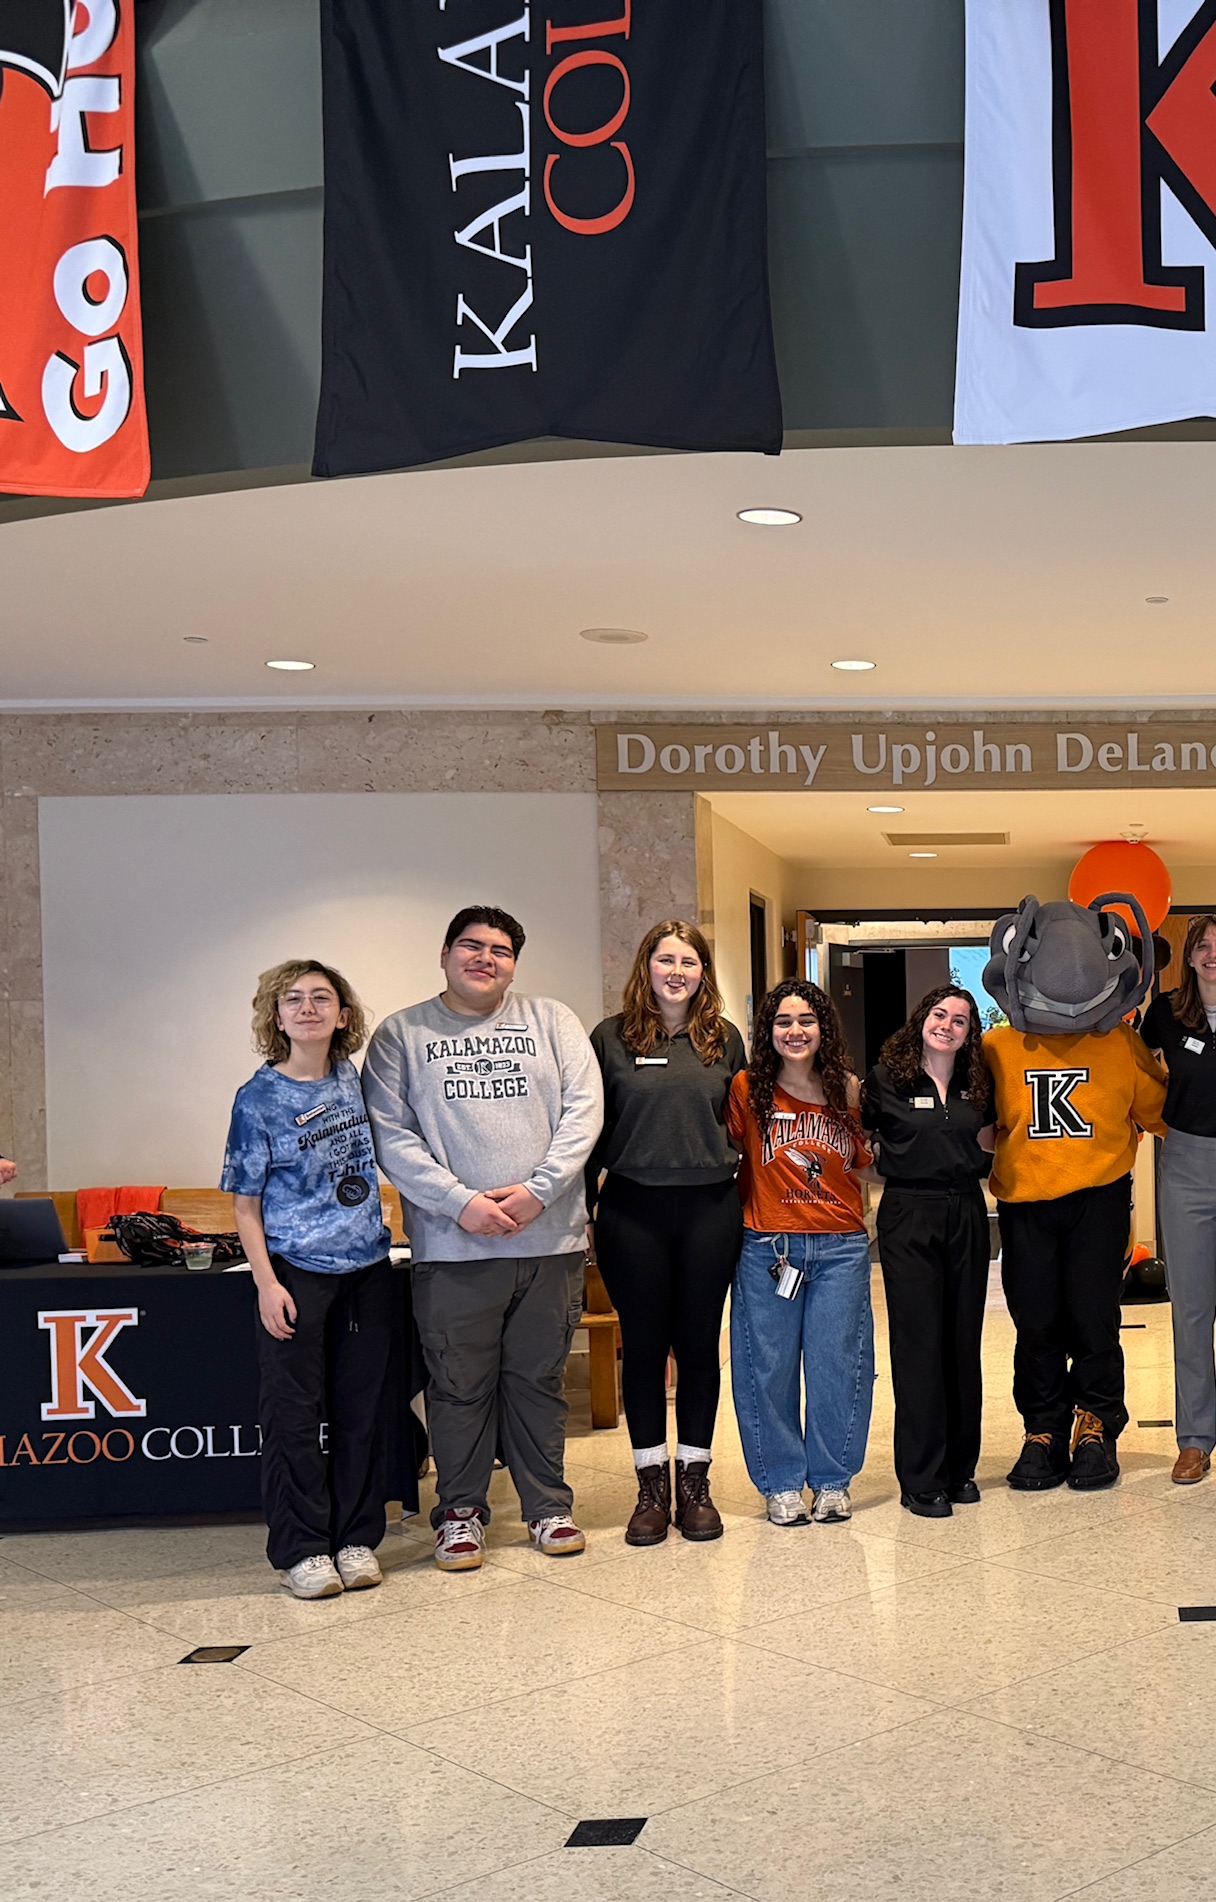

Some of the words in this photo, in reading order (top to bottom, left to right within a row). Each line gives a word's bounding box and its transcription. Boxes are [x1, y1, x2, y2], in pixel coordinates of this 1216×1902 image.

[437, 0, 537, 379] KALA
[616, 731, 828, 786] Dorothy
[851, 730, 1033, 786] Upjohn
[425, 1036, 537, 1063] KALAMAZOO
[443, 1076, 529, 1101] COLLEGE
[322, 1113, 340, 1124] WITH
[341, 1106, 356, 1117] THE
[1024, 1067, 1093, 1139] K
[330, 1134, 347, 1147] AND
[349, 1129, 363, 1139] ALL
[334, 1144, 350, 1156] GOT
[351, 1137, 370, 1148] WAS
[792, 1140, 831, 1154] COLLEGE
[328, 1157, 348, 1170] THIS
[347, 1147, 372, 1160] OUSY
[37, 1307, 147, 1421] K
